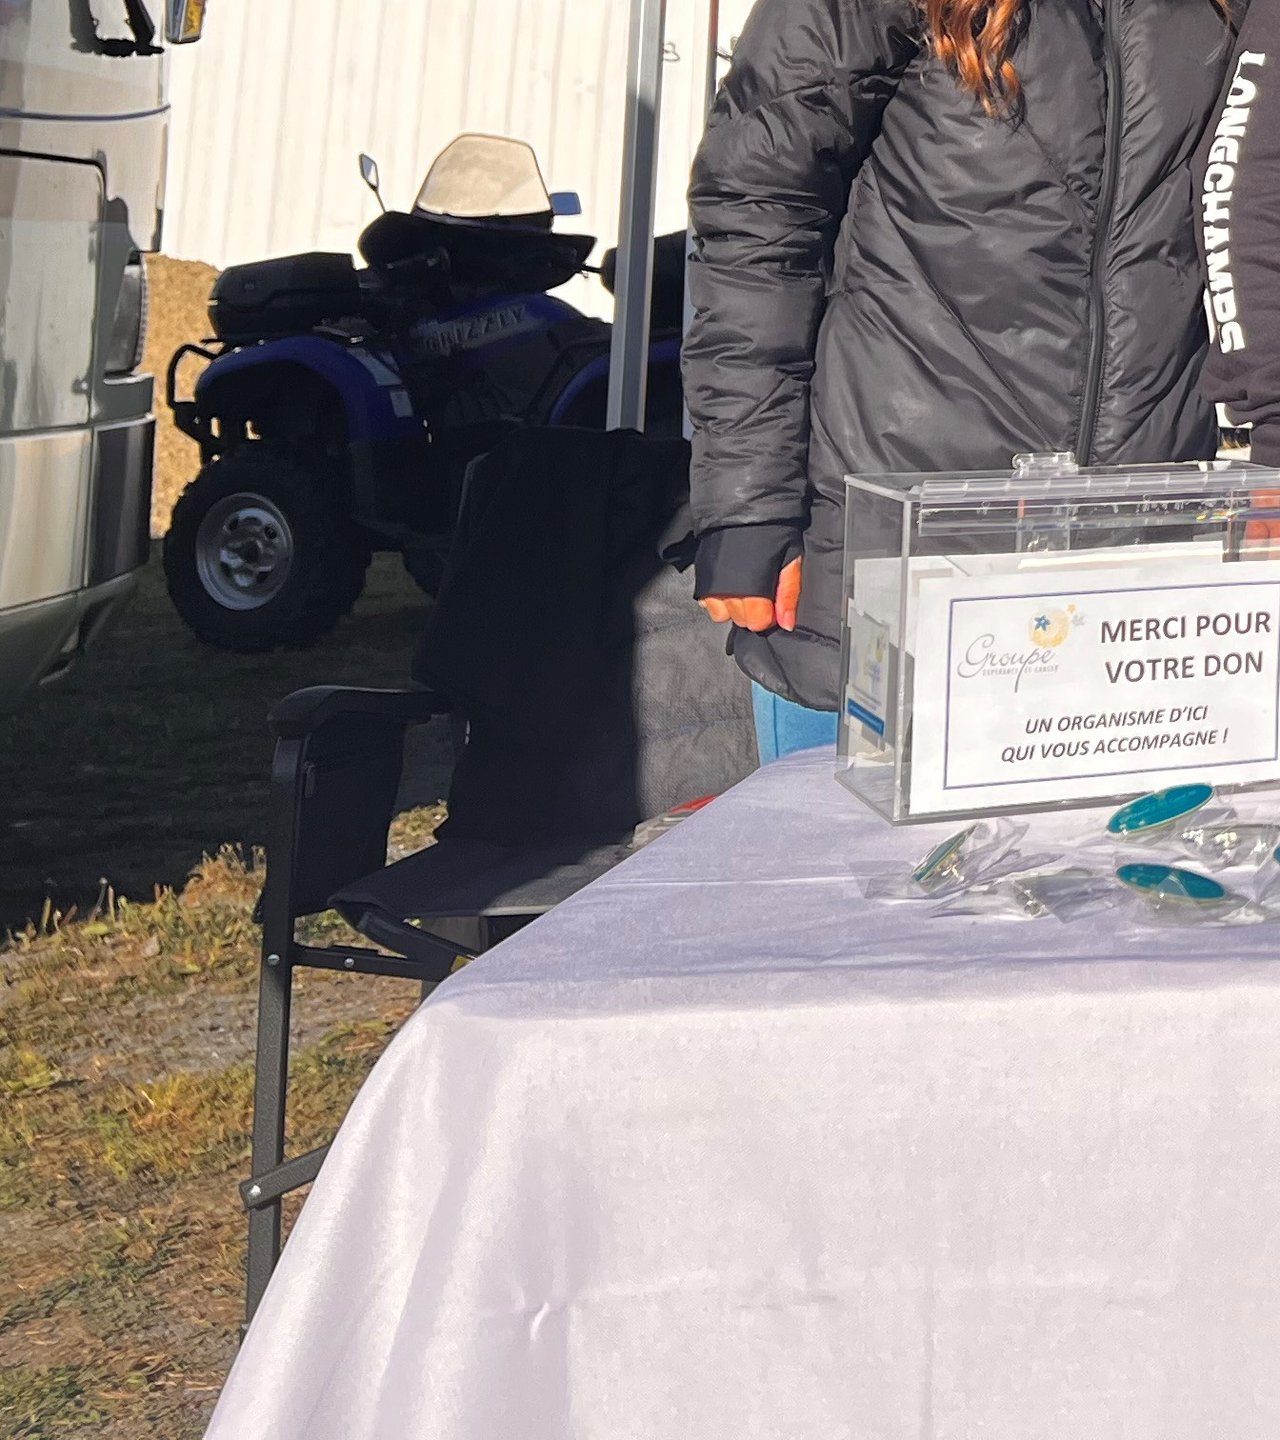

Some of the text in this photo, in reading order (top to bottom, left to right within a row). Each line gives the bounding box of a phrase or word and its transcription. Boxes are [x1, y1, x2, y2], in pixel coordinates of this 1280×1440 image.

[1203, 49, 1267, 355] LONGCHAMPS
[1100, 611, 1272, 645] MERCI POUR
[956, 633, 1056, 694] Groupe
[1105, 651, 1264, 685] VOTRE DON
[1025, 705, 1209, 735] UN ORGANISME D'ICI
[1000, 745, 1035, 764] QUI
[1039, 741, 1090, 759] VOUS
[1092, 731, 1218, 756] ACCOMPAGNE
